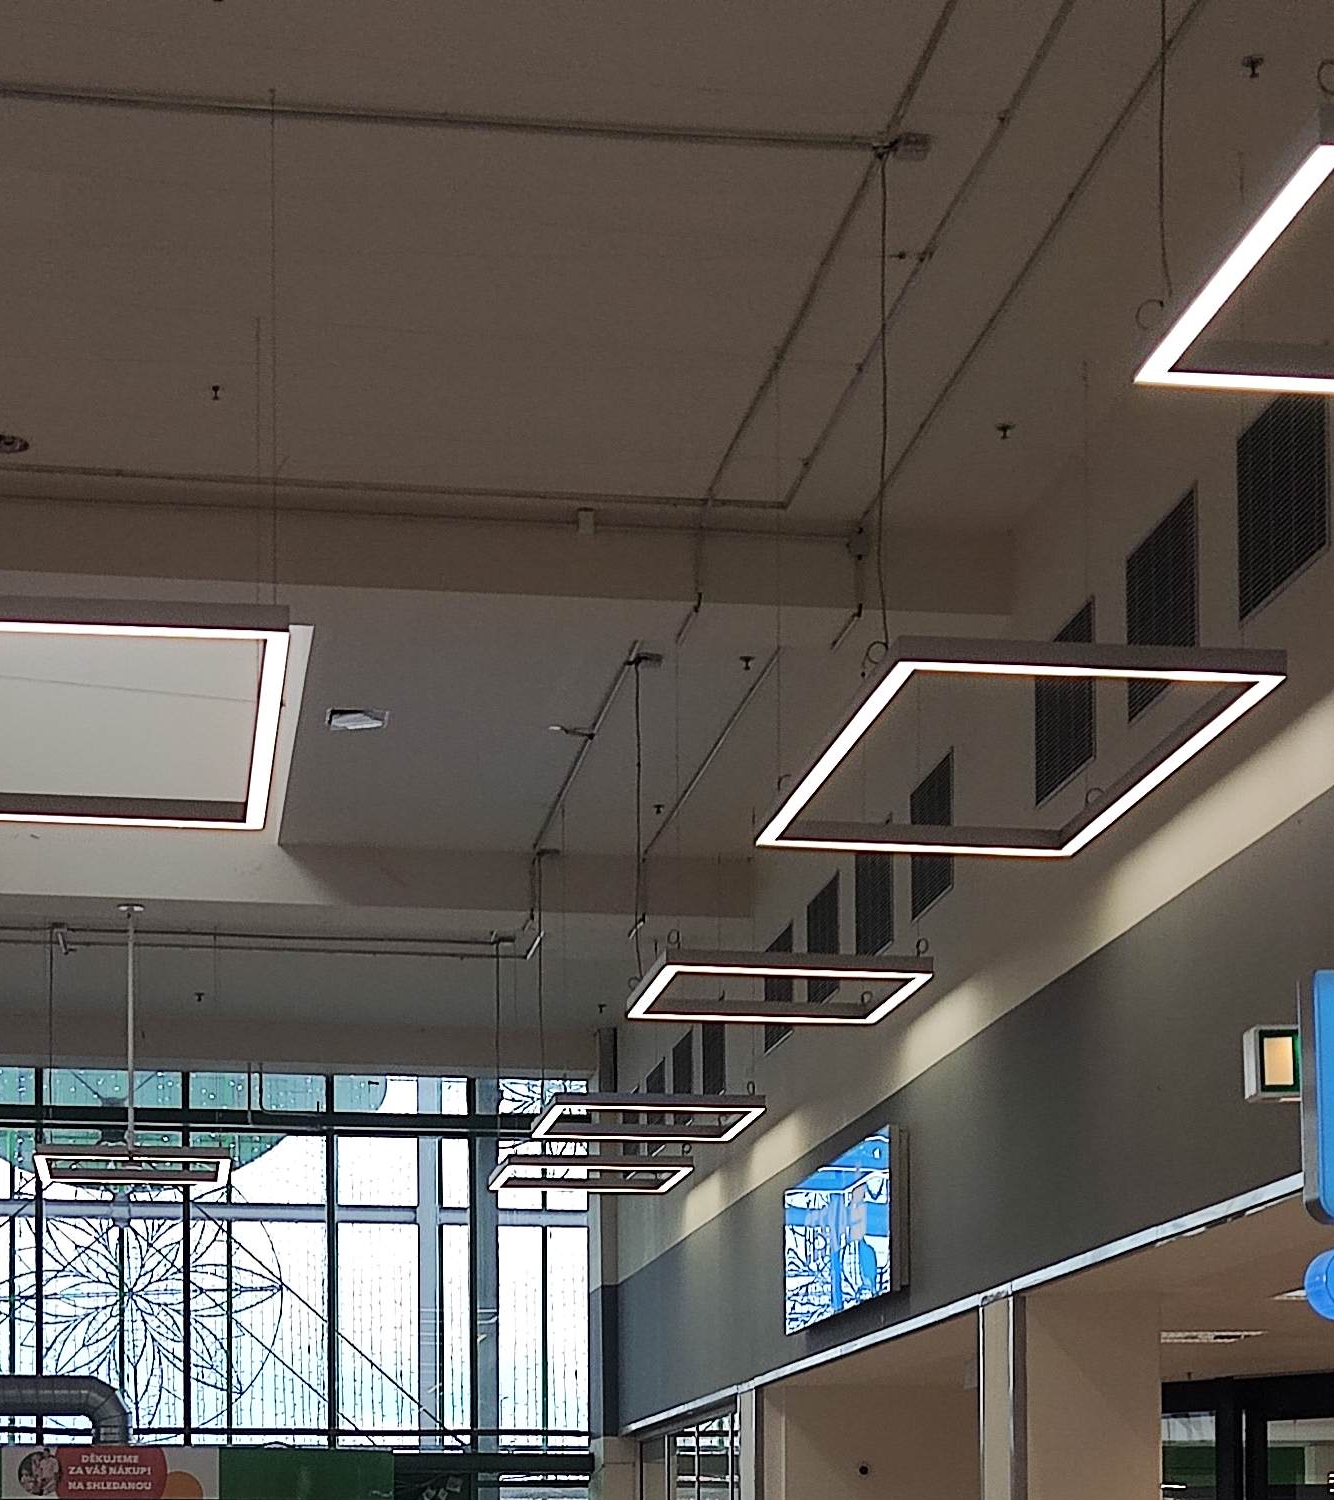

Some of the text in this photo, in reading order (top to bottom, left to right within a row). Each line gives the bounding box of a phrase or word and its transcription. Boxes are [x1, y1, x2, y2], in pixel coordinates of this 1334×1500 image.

[81, 1453, 139, 1464] DĚKUJEME
[68, 1465, 151, 1475] ZA VÁŠ NÁKUP!
[68, 1481, 152, 1490] NA SHLEDANOU
